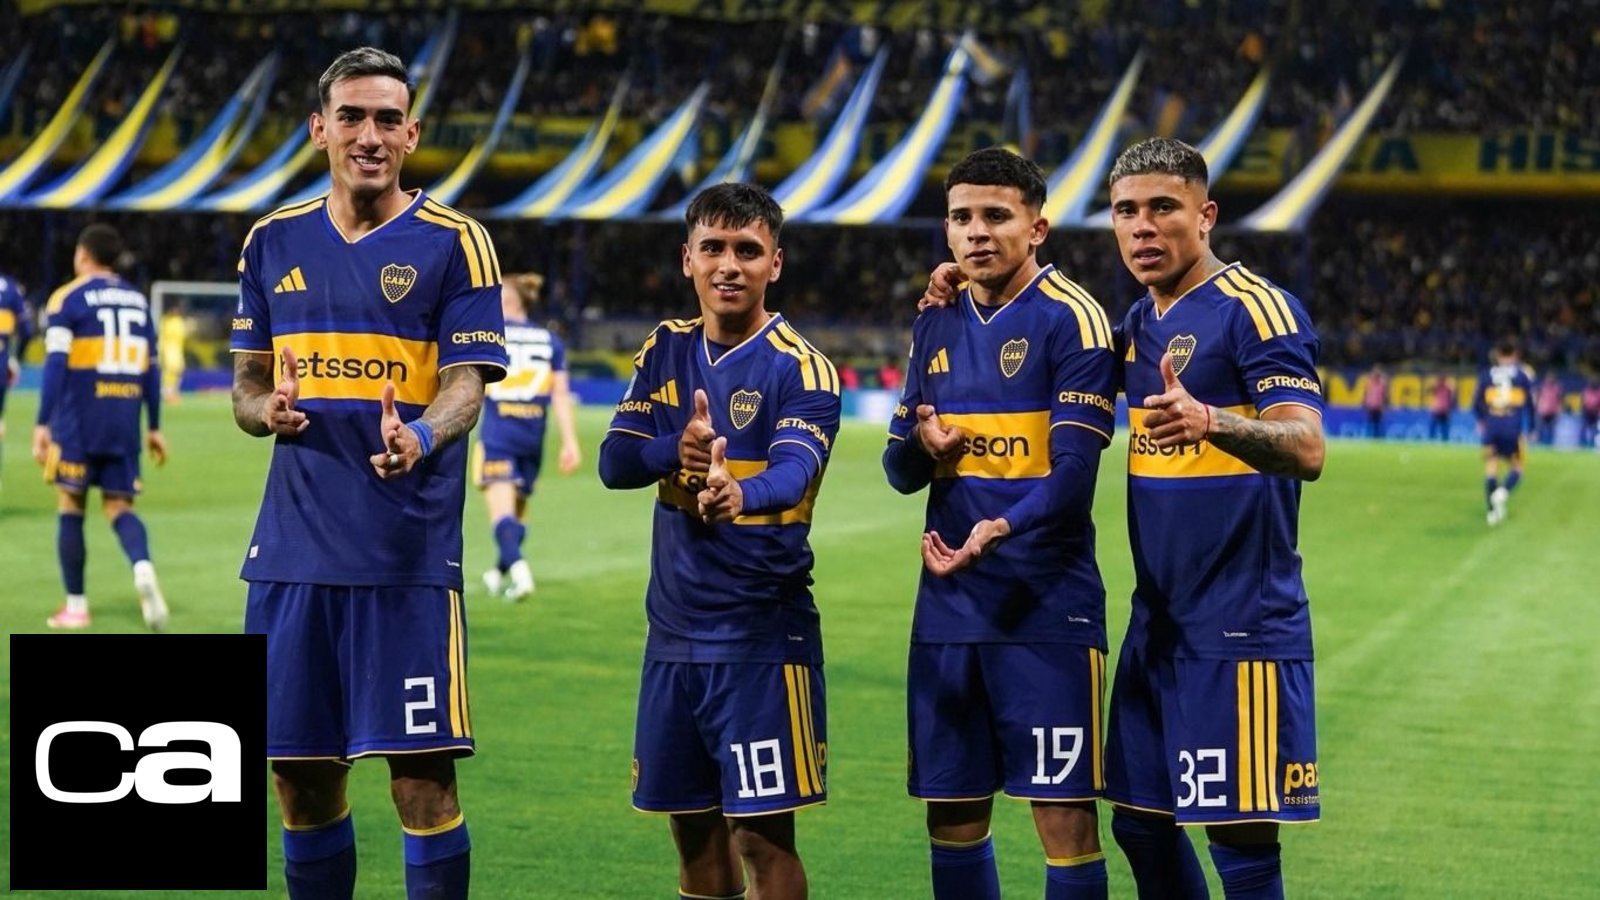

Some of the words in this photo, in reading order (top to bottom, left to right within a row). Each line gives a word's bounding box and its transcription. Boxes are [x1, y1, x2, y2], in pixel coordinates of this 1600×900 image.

[384, 275, 412, 287] CABJ
[96, 307, 149, 375] 16
[1003, 351, 1025, 361] CABJ
[733, 401, 758, 413] CABJ
[1058, 391, 1115, 416] CETROGA
[404, 676, 437, 735] 2
[730, 738, 786, 798] 18
[1031, 727, 1084, 784] 19
[1177, 748, 1227, 807] 32
